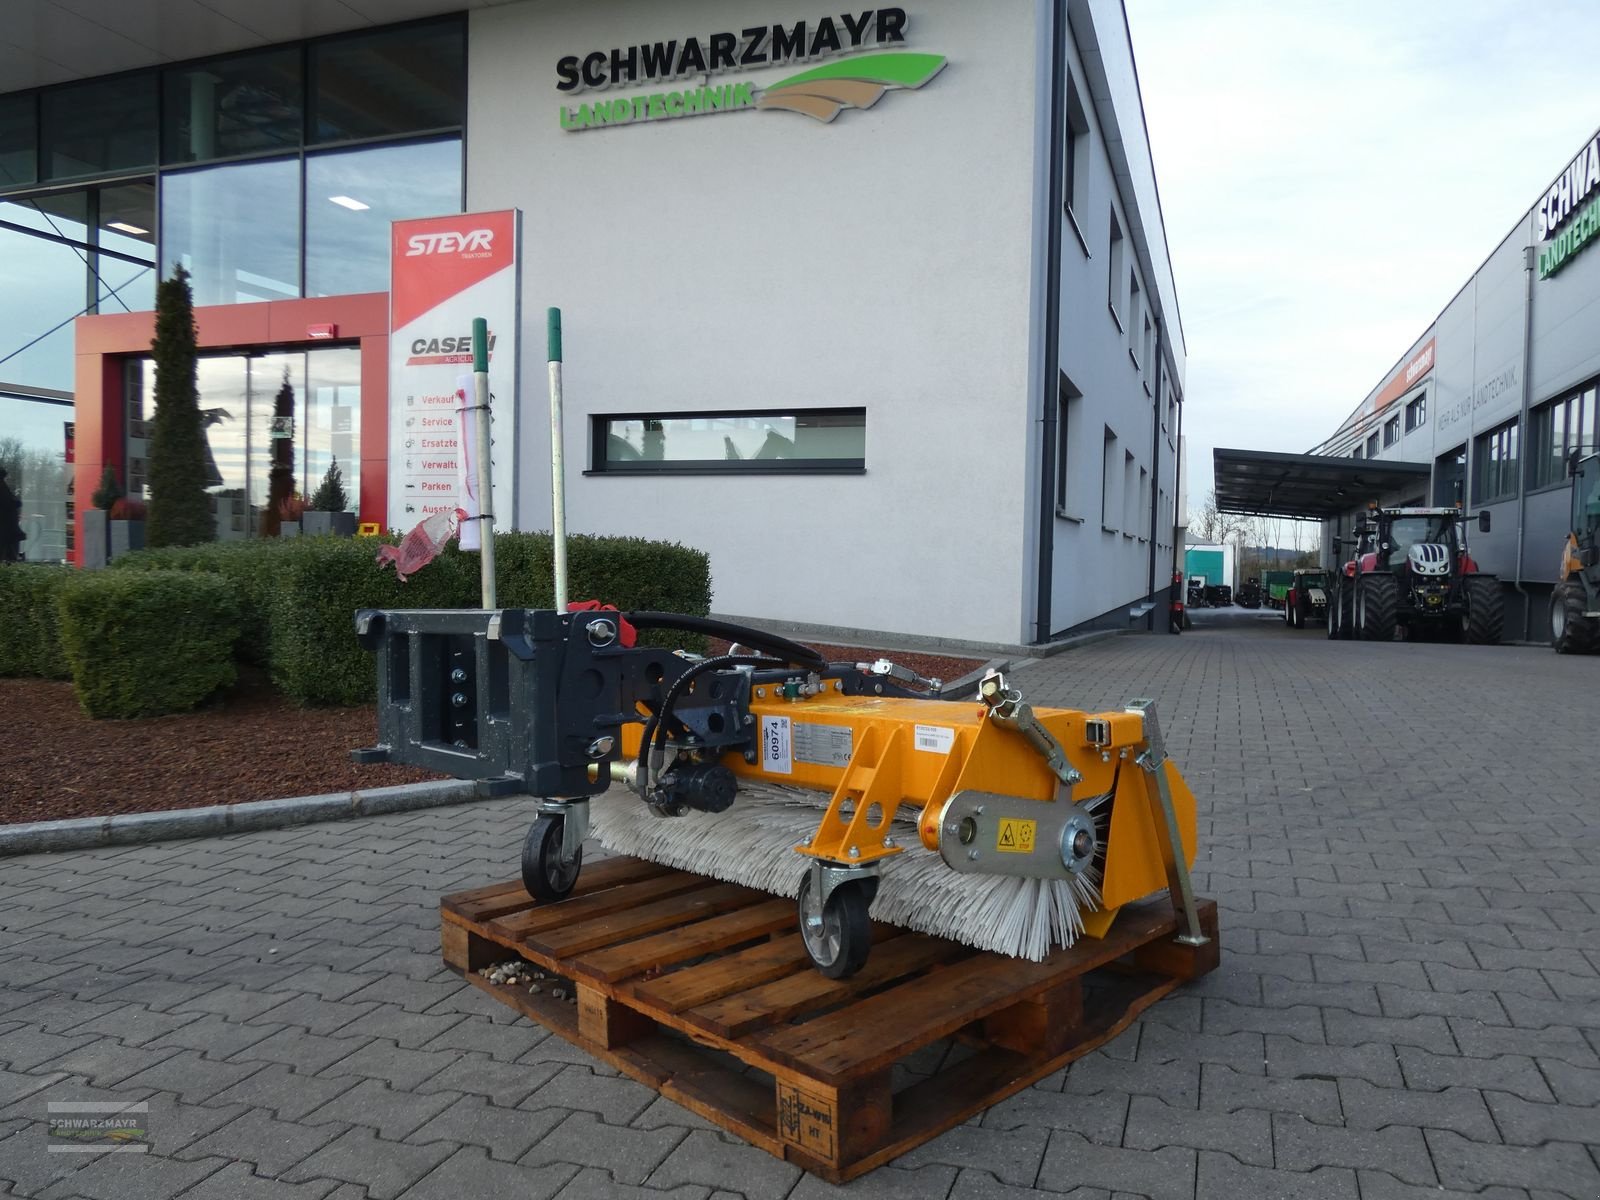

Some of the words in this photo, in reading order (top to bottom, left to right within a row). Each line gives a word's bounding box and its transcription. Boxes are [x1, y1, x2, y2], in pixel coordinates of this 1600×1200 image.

[556, 8, 906, 92] SCHWARZMAYR
[560, 81, 755, 130] LANDTECHNIK
[405, 229, 494, 257] STEYR
[411, 336, 473, 355] CASE
[444, 354, 474, 364] AGRICUL
[421, 396, 455, 404] Verkauf
[421, 417, 453, 426] Service
[421, 439, 458, 448] Ersatzte
[421, 481, 452, 491] Parken
[771, 721, 780, 761] 60974
